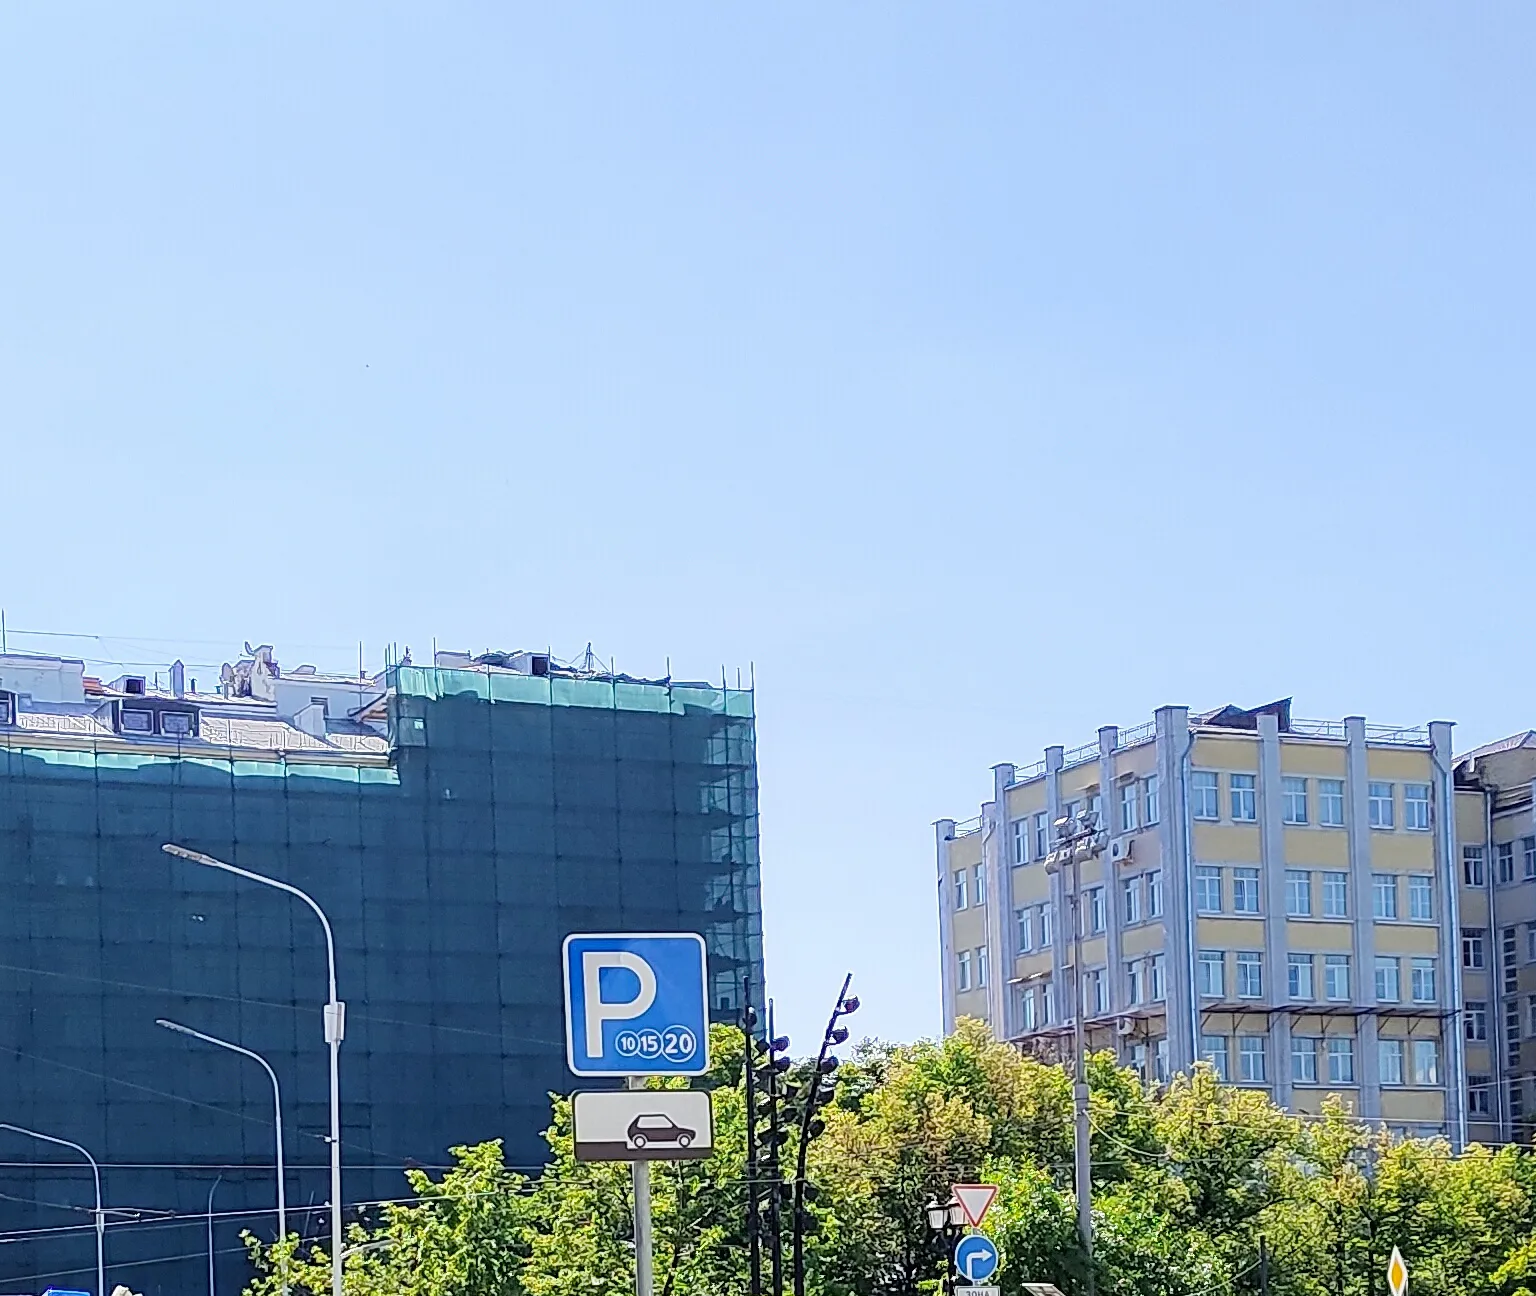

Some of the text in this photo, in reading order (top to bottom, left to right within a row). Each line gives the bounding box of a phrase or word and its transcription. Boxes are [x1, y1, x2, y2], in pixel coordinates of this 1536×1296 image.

[582, 951, 657, 1059] P
[620, 1033, 693, 1054] 10 15 20
